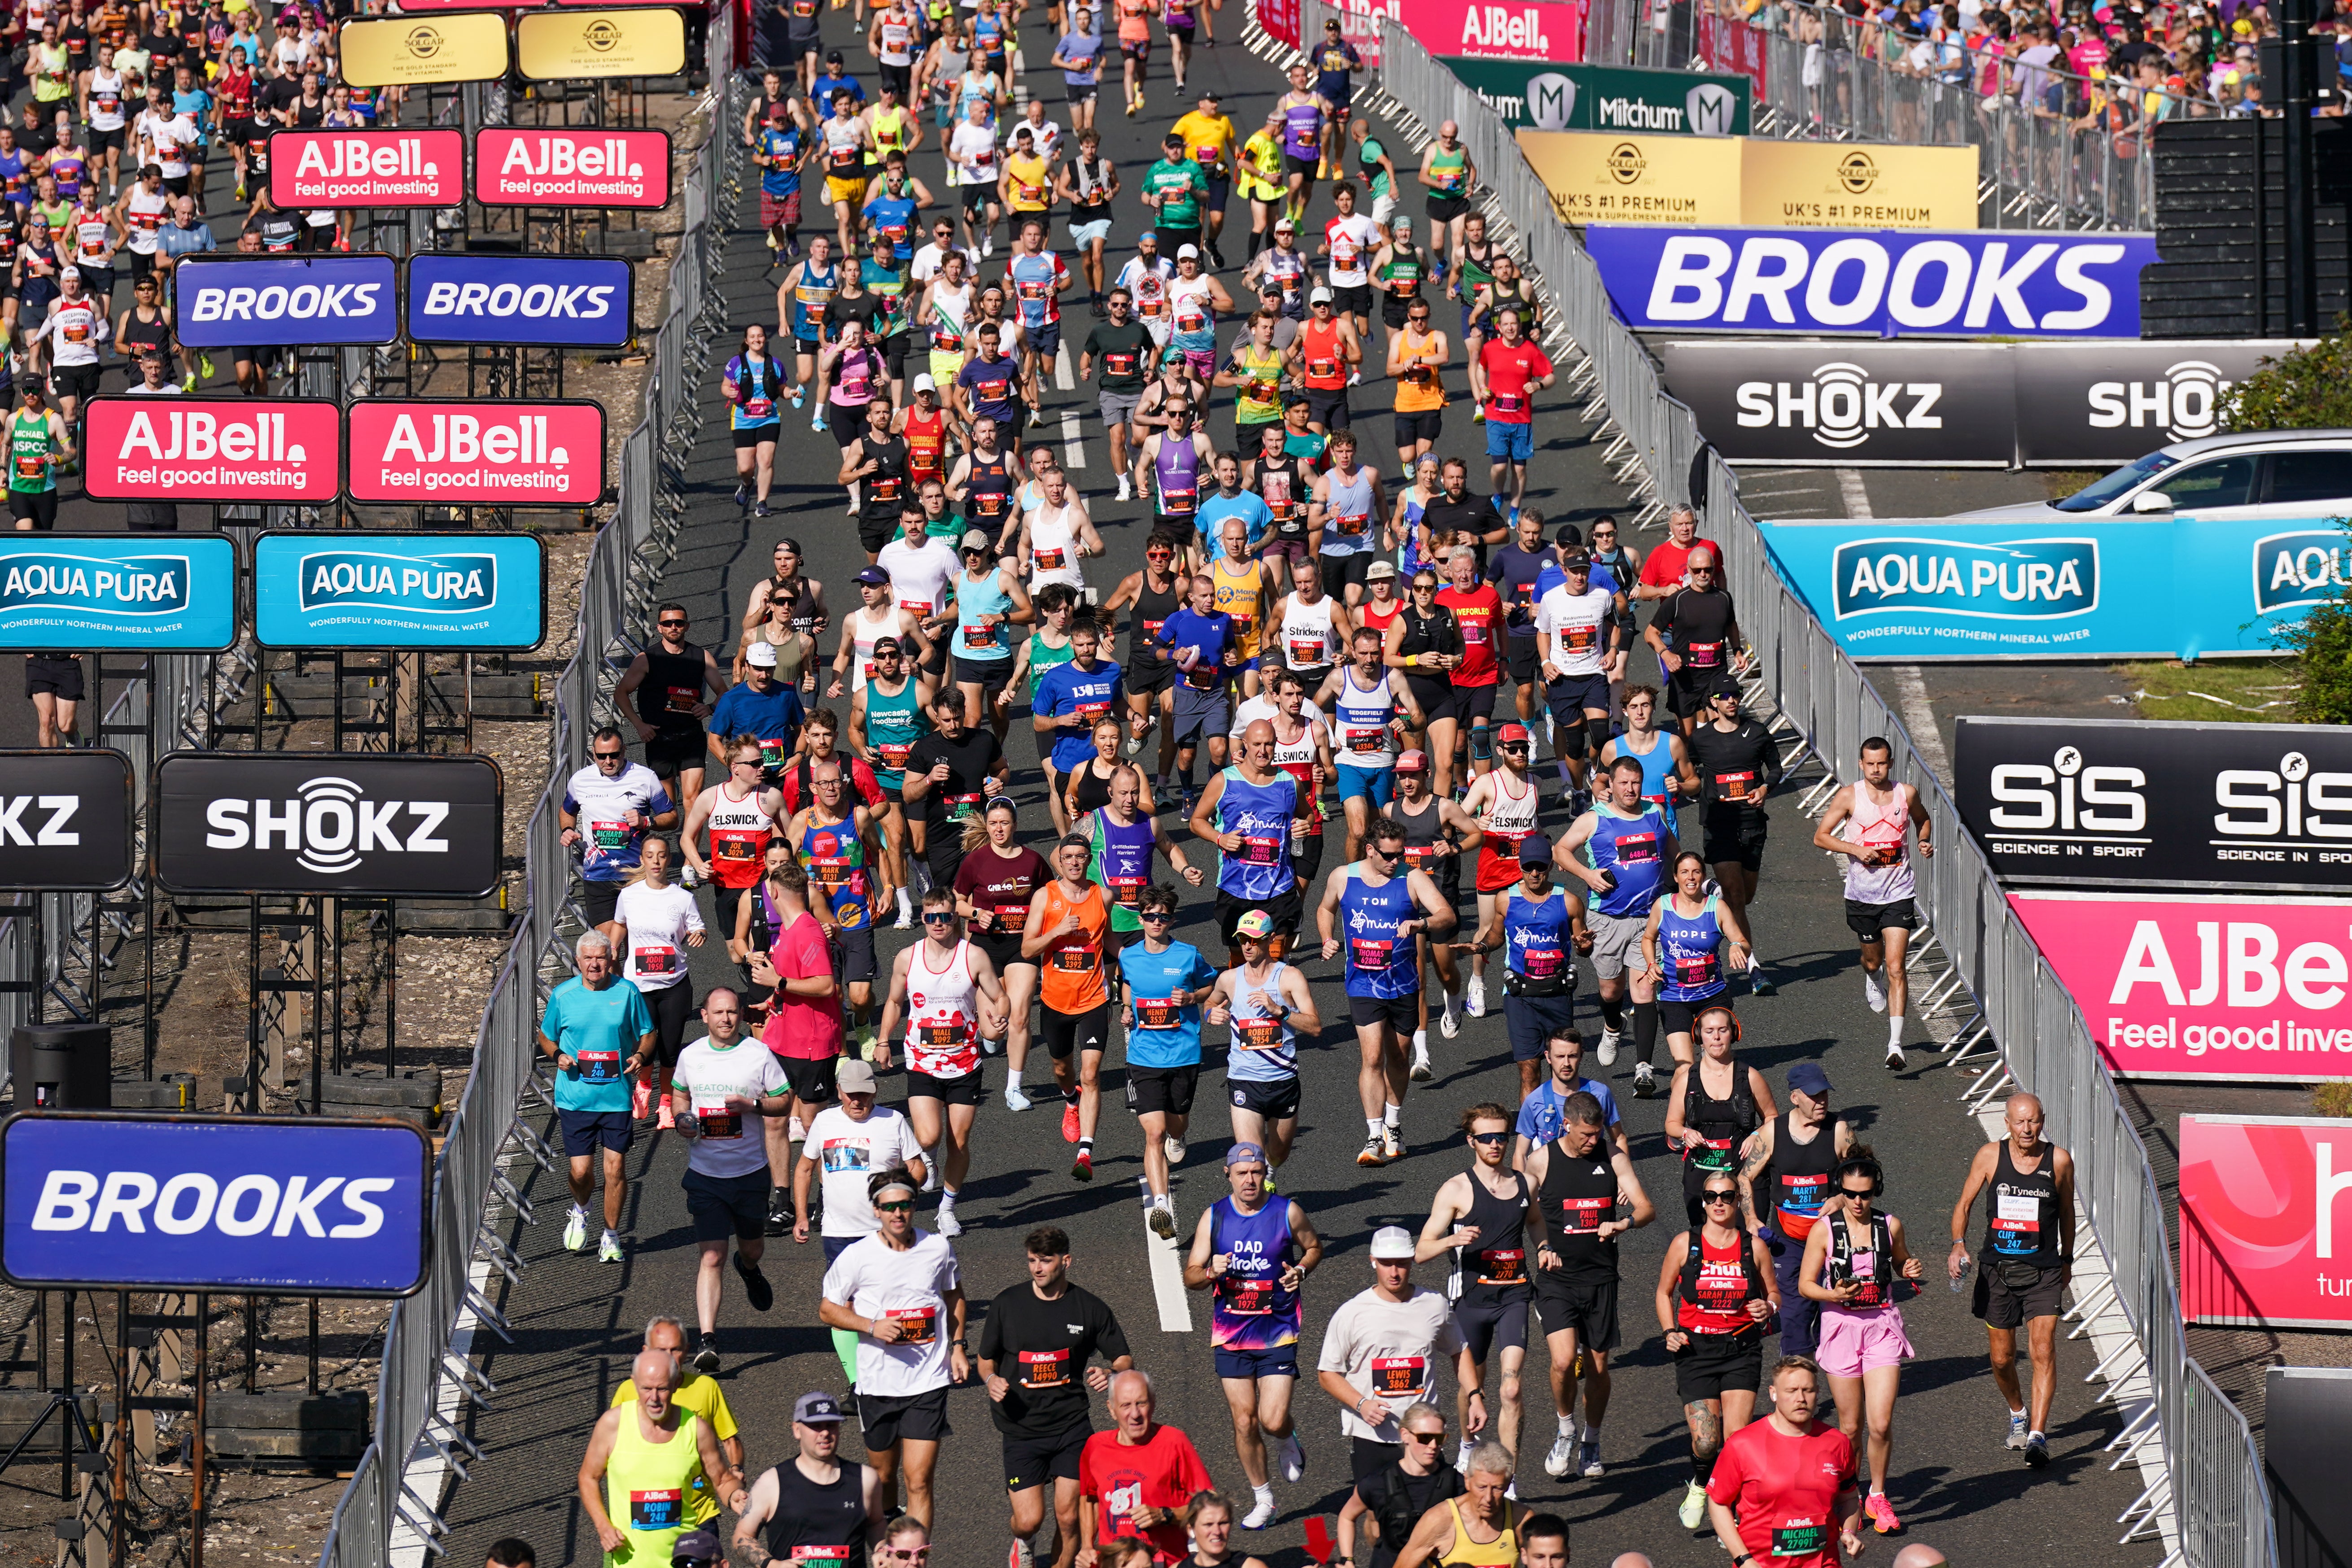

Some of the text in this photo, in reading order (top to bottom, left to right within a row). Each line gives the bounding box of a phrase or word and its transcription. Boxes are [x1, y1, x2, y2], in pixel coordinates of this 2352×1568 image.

[1462, 5, 1539, 51] AJBell
[582, 31, 622, 39] SOLGAR
[405, 37, 444, 48] SOLGAR
[1600, 97, 1680, 131] Mitchum
[296, 140, 420, 176] AJBell
[501, 138, 626, 176] AJBell
[1607, 158, 1646, 169] SOLGAR
[1836, 167, 1879, 179] SOLGAR
[296, 180, 439, 198] Feel good investing
[501, 179, 643, 198] Feel good investing
[1557, 193, 1696, 211] UK'S #1 PREMIUM
[1605, 212, 1662, 222] SUPPLEMENT
[1783, 203, 1930, 221] UK'S #1 PREMIUM
[1647, 236, 2126, 329] BROOKS
[192, 284, 380, 321] BROOKS
[424, 283, 614, 318] BROOKS
[981, 387, 1005, 395] JONATHAN
[1737, 383, 1942, 429] SHOKZ
[14, 430, 45, 439] MICHAEL
[118, 411, 284, 461] AJBell
[382, 415, 546, 463] AJBell
[13, 442, 47, 453] NSPCC
[118, 466, 306, 489] Feel good investing
[382, 468, 569, 492] Feel good investing
[311, 563, 484, 599] AQUA PURA
[1847, 552, 2084, 601] AQUA PURA
[4, 565, 177, 601] AQUA PURA
[1, 619, 64, 629] WONDERFULLY
[67, 620, 113, 630] NORTHERN
[154, 623, 182, 632] WATER
[309, 617, 371, 627] WONDERFULLY
[374, 619, 420, 629] NORTHERN
[462, 621, 489, 630] WATER
[1289, 627, 1324, 638] Striders
[871, 710, 910, 718] Newcastle
[872, 717, 905, 725] Foodbank
[1729, 782, 1744, 791] BENJ
[1989, 747, 2146, 830] SiS
[1729, 788, 1744, 797] 3835
[715, 815, 758, 826] ELSWICK
[207, 801, 449, 852] SHOKZ
[596, 830, 623, 839] RICHARD
[599, 837, 619, 845] 21250
[814, 838, 835, 846] SUPPORT
[1252, 846, 1270, 854] CHRIS
[1629, 850, 1648, 859] 64841
[2067, 844, 2146, 857] IN SPORT
[1250, 853, 1270, 861] 62826
[2293, 852, 2308, 861] IN
[821, 866, 839, 874] MARK
[1121, 893, 1136, 901] 3680
[1362, 897, 1388, 906] TOM
[1670, 930, 1707, 940] HOPE
[1064, 953, 1083, 961] GREG
[1359, 949, 1384, 958] THOMAS
[646, 956, 664, 964] JODIE
[1065, 960, 1082, 968] 3392
[1361, 956, 1381, 965] 62806
[647, 962, 664, 971] 1950
[1688, 966, 1705, 975] HOPE
[1146, 1008, 1168, 1016] HENRY
[1150, 1015, 1166, 1023] 3537
[932, 1027, 952, 1036] NIALL
[1247, 1027, 1273, 1036] ROBERT
[2109, 1018, 2280, 1052] Feel good
[933, 1035, 951, 1044] 3092
[1252, 1035, 1269, 1044] 2954
[591, 1069, 605, 1078] 240
[693, 1084, 732, 1092] HEATON
[707, 1118, 730, 1127] DANIEL
[710, 1125, 728, 1134] 2395
[1792, 1186, 1818, 1197] MARTY
[2011, 1186, 2050, 1198] Tynedale
[1799, 1194, 1812, 1203] 281
[31, 1171, 394, 1238] BROOKS
[1579, 1210, 1598, 1219] PAUL
[1580, 1219, 1598, 1227] 1304
[1998, 1230, 2016, 1239] CLIFF
[1234, 1240, 1263, 1253] DAD
[2007, 1240, 2022, 1249] 247
[1490, 1262, 1517, 1270] PATRICK
[1697, 1291, 1720, 1300] SARAH
[1237, 1299, 1256, 1310] 1975
[1712, 1299, 1732, 1308] 2222
[1032, 1363, 1056, 1373] REECE
[1385, 1360, 1411, 1368] AJBell
[1033, 1371, 1057, 1382] 14990
[1386, 1369, 1411, 1380] LEWIS
[1389, 1378, 1409, 1389] 3862
[643, 1502, 671, 1512] ROBIN
[650, 1512, 666, 1523] 248
[1781, 1528, 1818, 1540] MICHAEL
[1787, 1537, 1814, 1548] 27991
